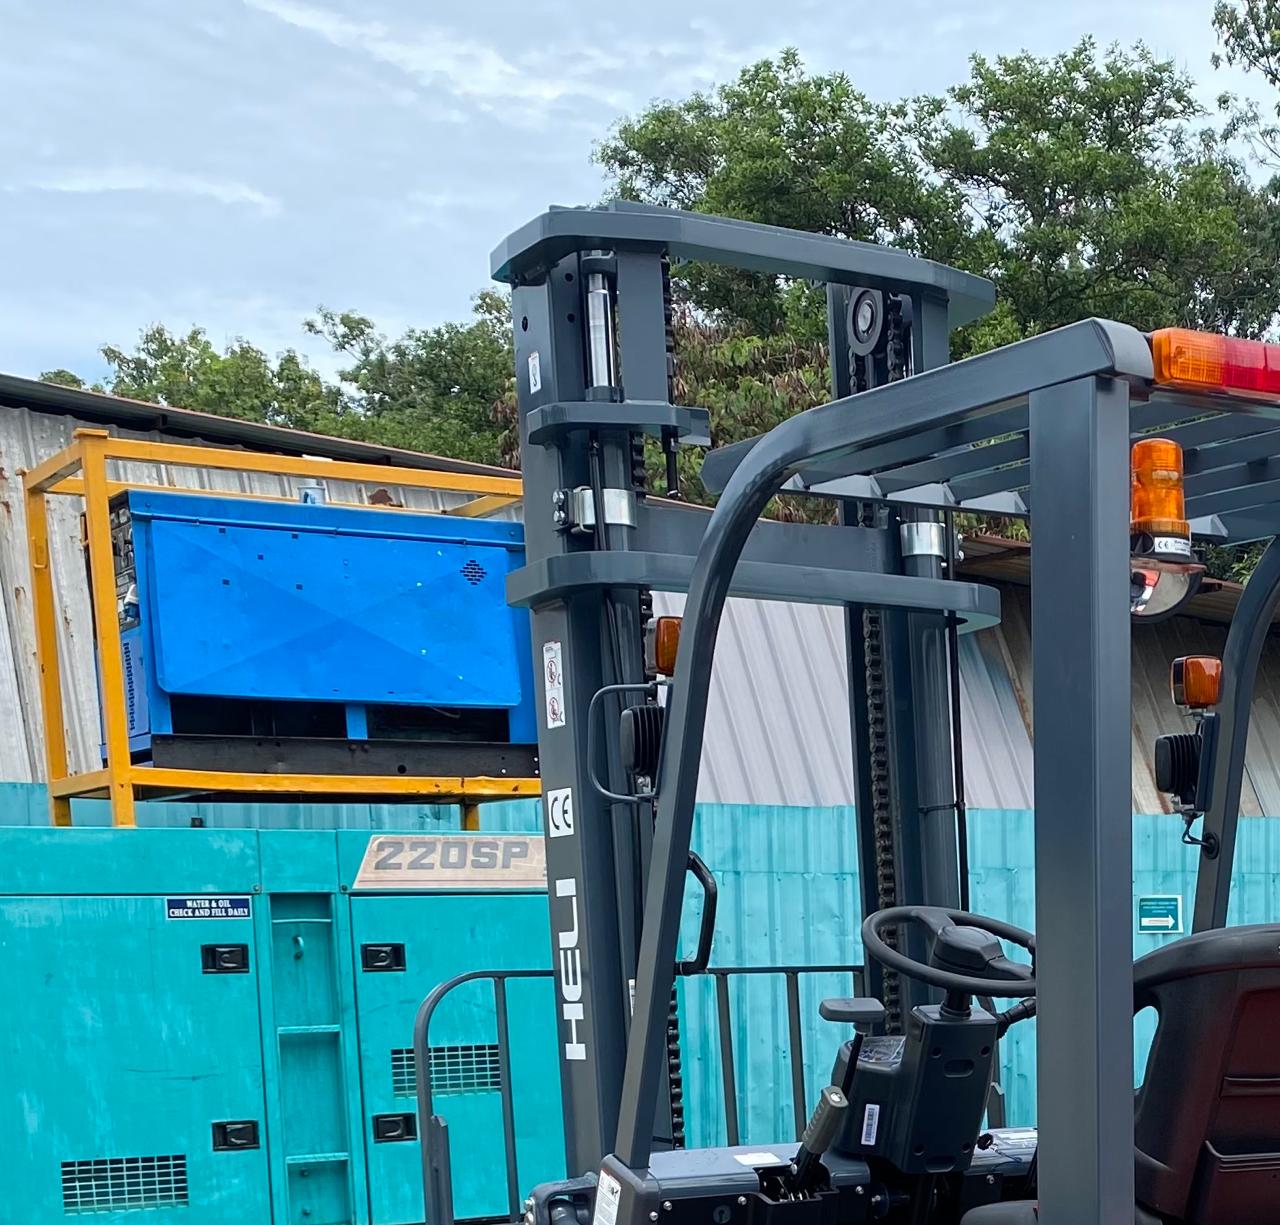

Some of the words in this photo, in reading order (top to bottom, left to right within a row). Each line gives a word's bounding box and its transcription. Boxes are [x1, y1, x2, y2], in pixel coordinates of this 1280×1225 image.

[551, 794, 571, 830] CE
[374, 841, 529, 870] 220SP
[169, 908, 193, 917] CHECK
[194, 908, 210, 917] AND
[211, 908, 226, 916] FILL
[227, 908, 248, 916] DAILY
[186, 900, 210, 908] WATER
[211, 900, 217, 908] &
[218, 900, 231, 908] OIL
[556, 878, 586, 1060] HELI
